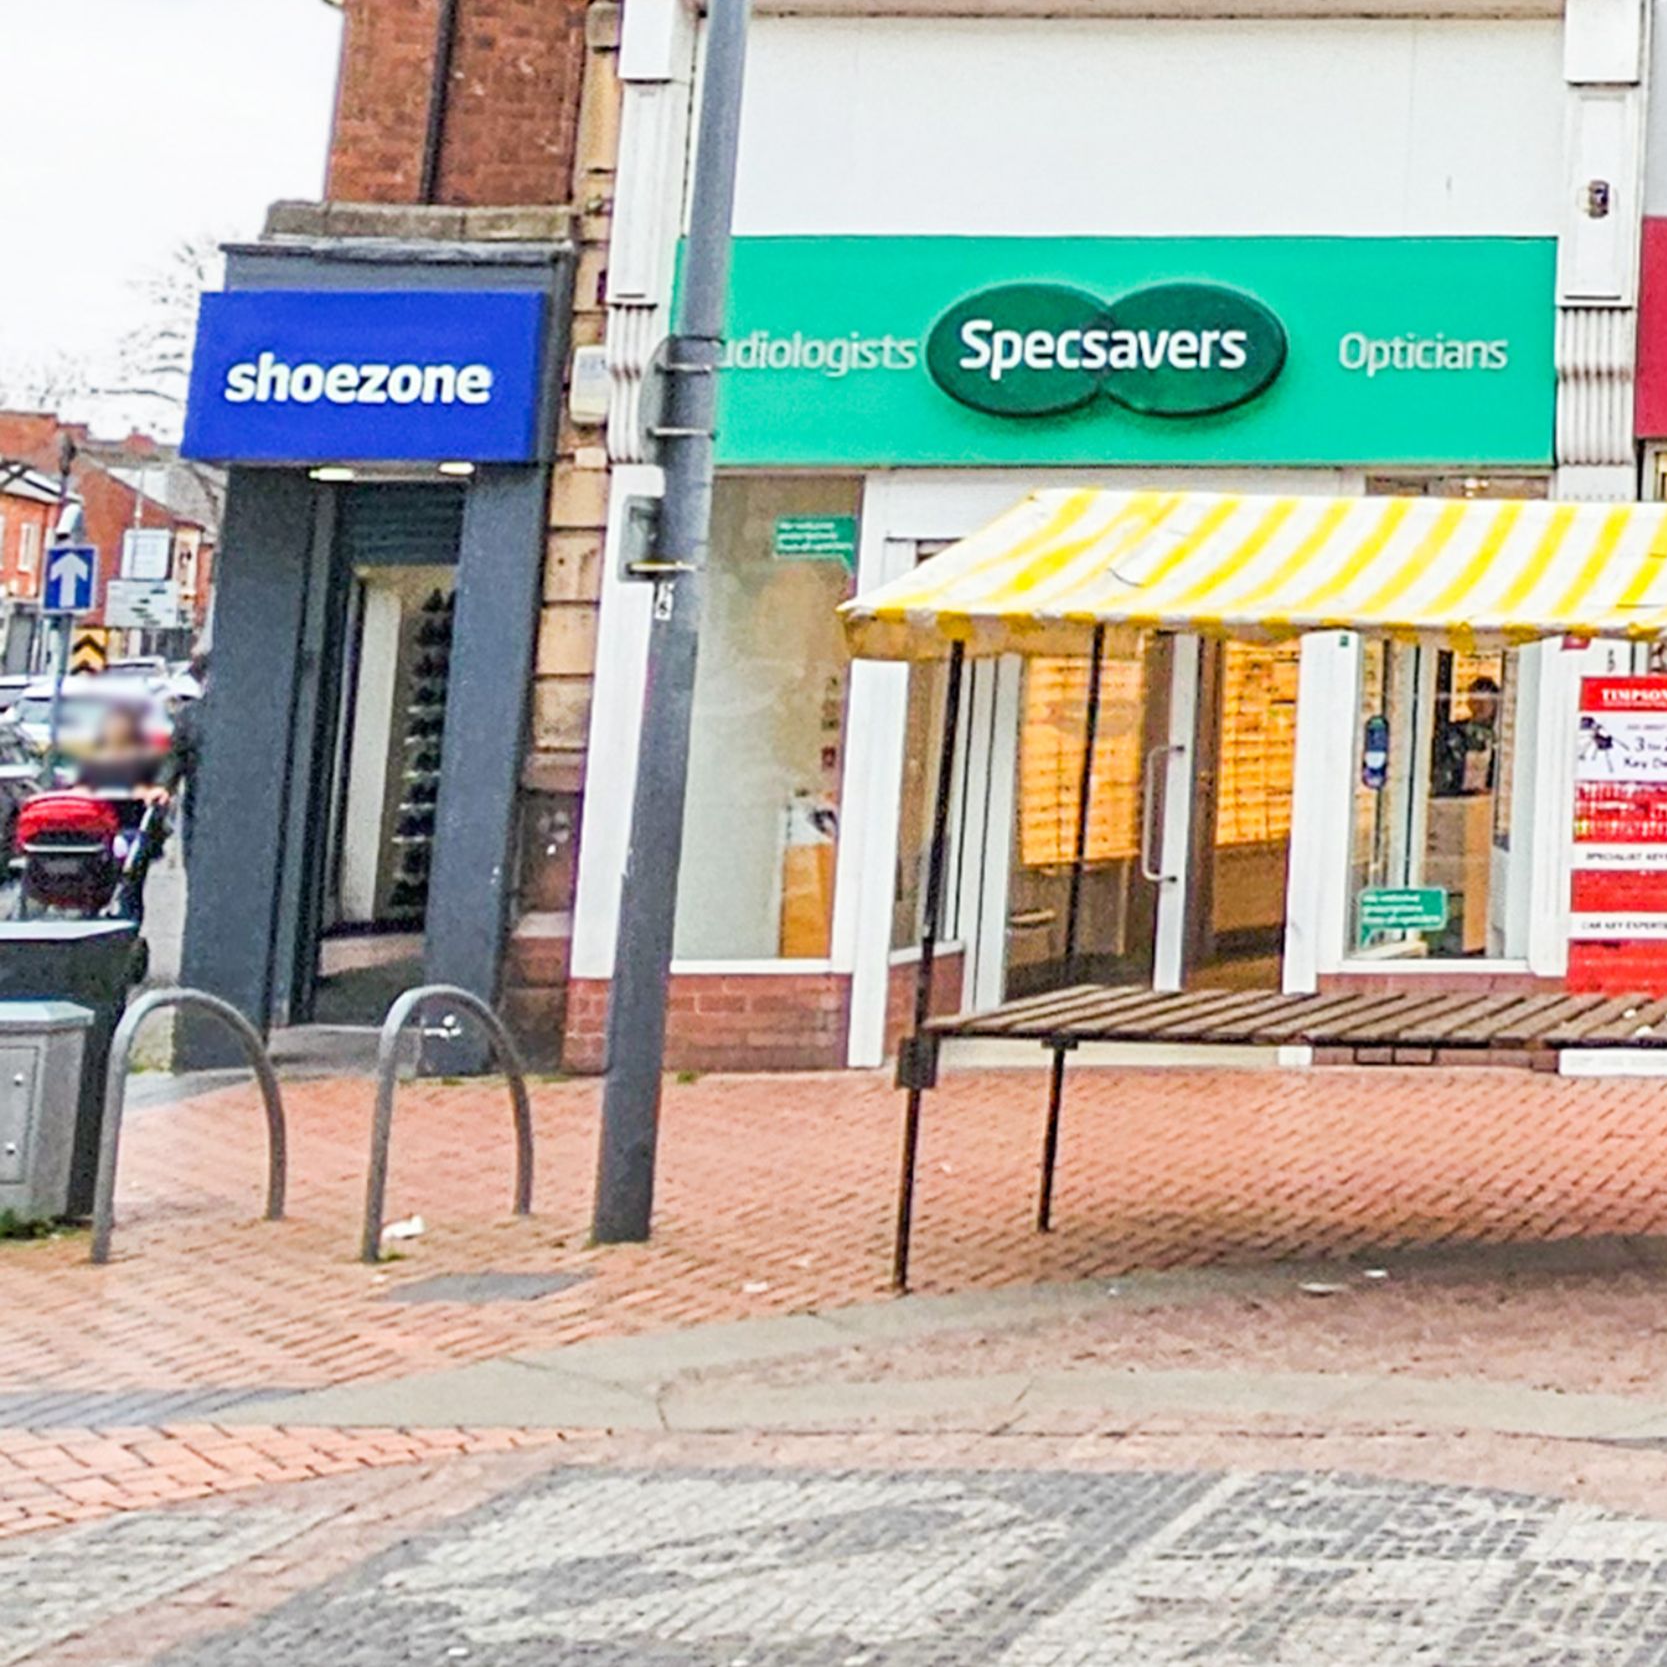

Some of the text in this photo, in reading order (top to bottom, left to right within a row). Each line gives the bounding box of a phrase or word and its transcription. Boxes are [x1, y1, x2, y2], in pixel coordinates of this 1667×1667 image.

[714, 329, 919, 378] udiologists
[959, 319, 1248, 380] Specsavers
[1338, 330, 1509, 378] Opticians
[224, 352, 493, 405] shoezone
